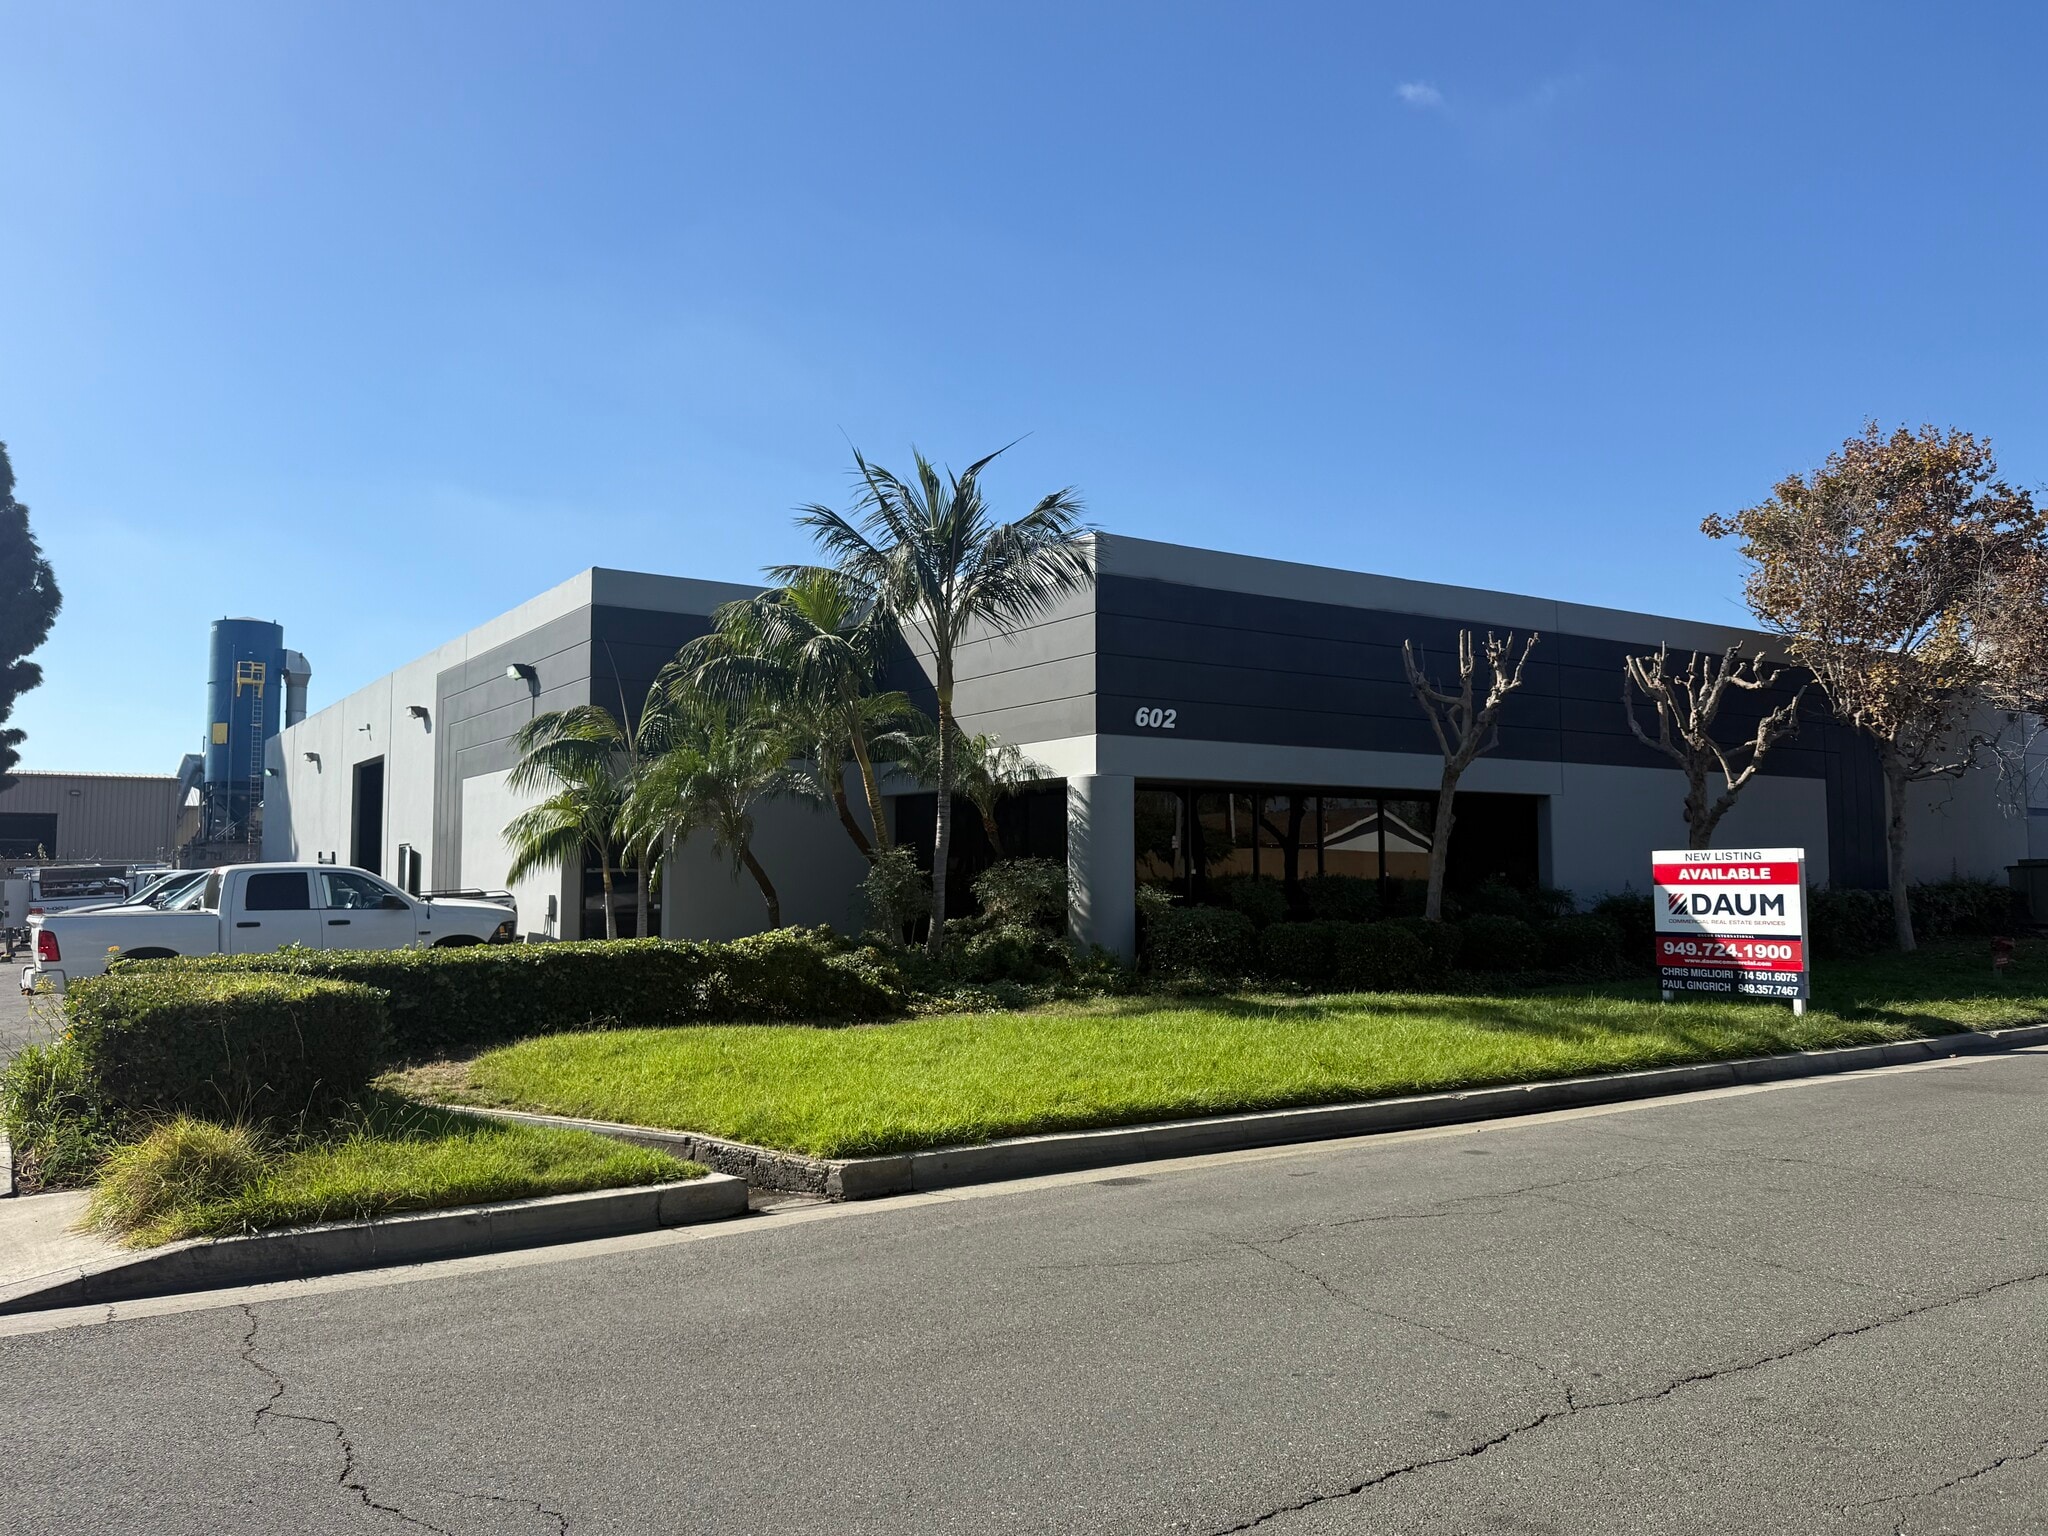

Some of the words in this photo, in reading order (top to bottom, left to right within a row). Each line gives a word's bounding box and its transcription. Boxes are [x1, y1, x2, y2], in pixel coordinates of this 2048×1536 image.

[1135, 706, 1177, 729] 602
[1685, 852, 1711, 861] NEW
[1715, 851, 1762, 861] LISTING
[1678, 868, 1771, 880] AVAILABLE
[1692, 893, 1785, 916] DAUM
[1663, 942, 1792, 959] 949.724.1900
[1662, 967, 1689, 977] CHRIS
[1690, 969, 1734, 979] MIGLIOIRI
[1662, 980, 1685, 990] PAUL
[1686, 981, 1731, 992] GINGRICH
[1738, 984, 1799, 996] 949.357.7467
